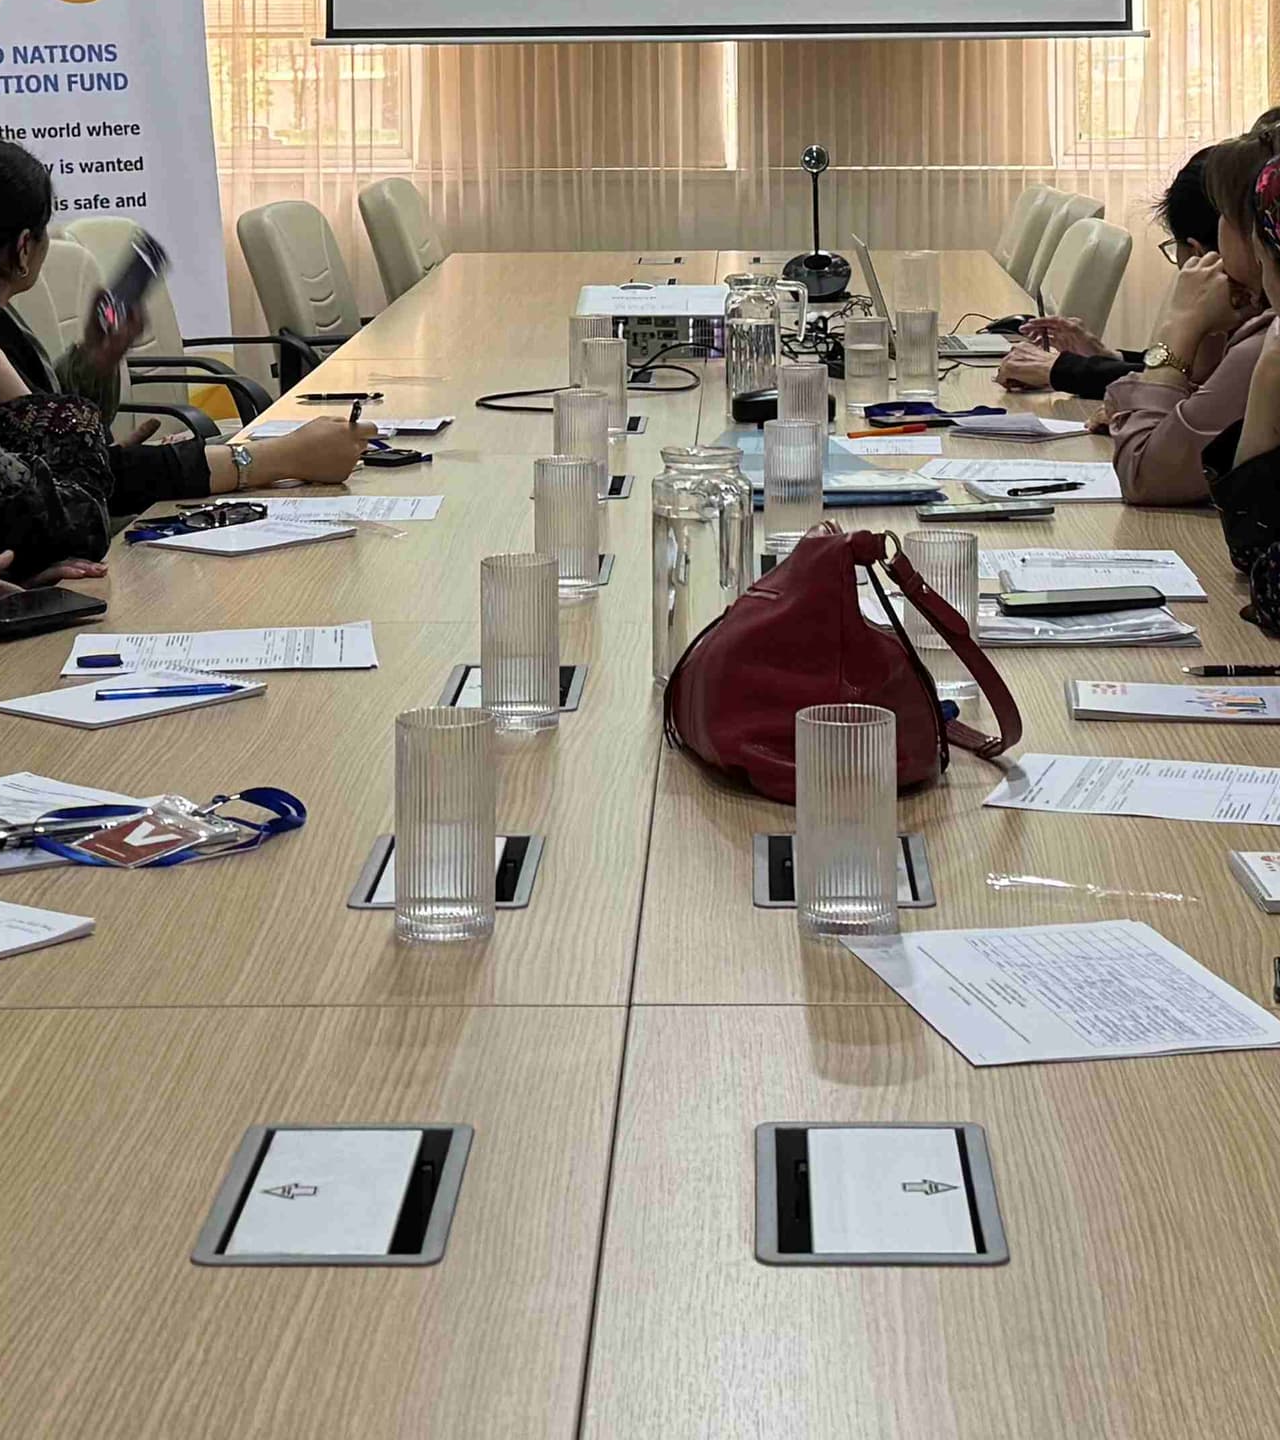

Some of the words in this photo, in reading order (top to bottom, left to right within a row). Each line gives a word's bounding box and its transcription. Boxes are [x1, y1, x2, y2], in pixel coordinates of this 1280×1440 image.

[12, 44, 117, 64] NATIONS
[67, 73, 128, 92] FUND
[32, 122, 81, 139] world
[87, 121, 141, 137] where
[60, 159, 74, 174] is
[79, 156, 144, 173] wanted
[54, 195, 69, 211] is
[74, 194, 110, 210] safe
[115, 192, 147, 208] and
